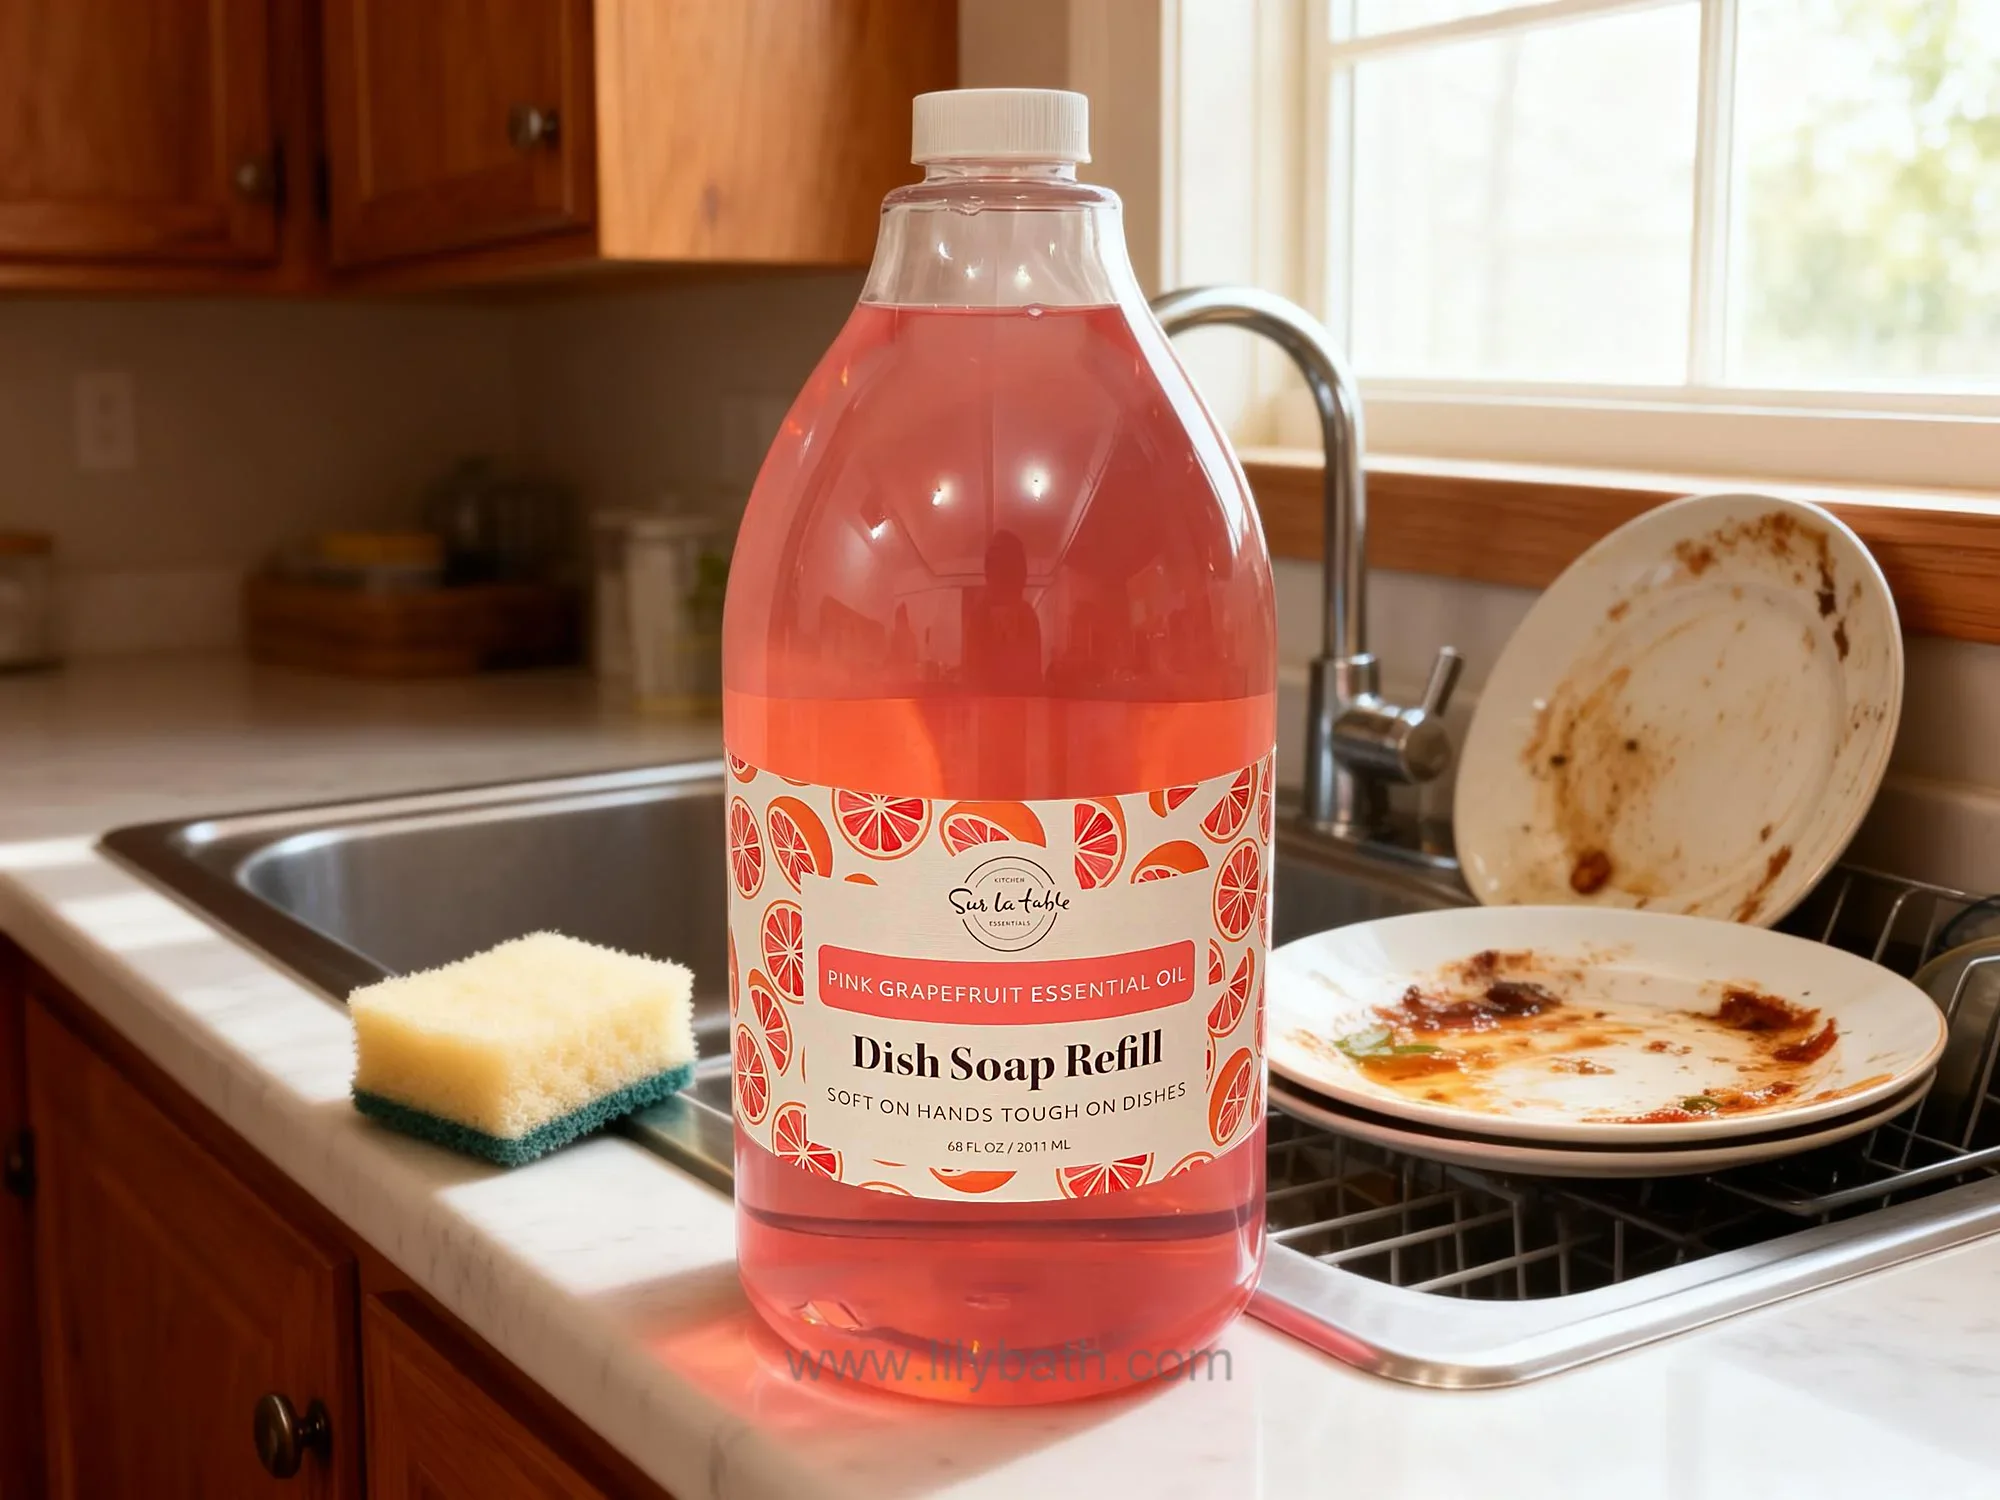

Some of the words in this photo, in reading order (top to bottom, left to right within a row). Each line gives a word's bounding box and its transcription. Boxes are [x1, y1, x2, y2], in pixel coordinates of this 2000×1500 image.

[948, 887, 988, 914] Sur
[994, 891, 1016, 912] la
[1018, 887, 1070, 913] table
[828, 968, 874, 995] PINK
[879, 979, 1022, 1004] GRAPEFRUIT
[1031, 974, 1151, 1003] ESSENTIAL
[1156, 965, 1186, 988] OIL
[852, 1033, 941, 1079] Dish
[950, 1044, 1056, 1091] Soap
[1066, 1028, 1163, 1078] Refill
[827, 1086, 874, 1111] SOFT
[880, 1099, 910, 1117] ON
[917, 1104, 993, 1123] HANDS
[1001, 1103, 1078, 1123] TOUGH
[1086, 1097, 1116, 1116] ON
[1123, 1081, 1187, 1112] DISHES
[947, 1141, 964, 1152] 68
[966, 1142, 981, 1153] FL
[984, 1142, 1004, 1153] OZ
[1007, 1141, 1014, 1155] /
[1017, 1141, 1048, 1153] 2011
[1050, 1140, 1071, 1152] ML
